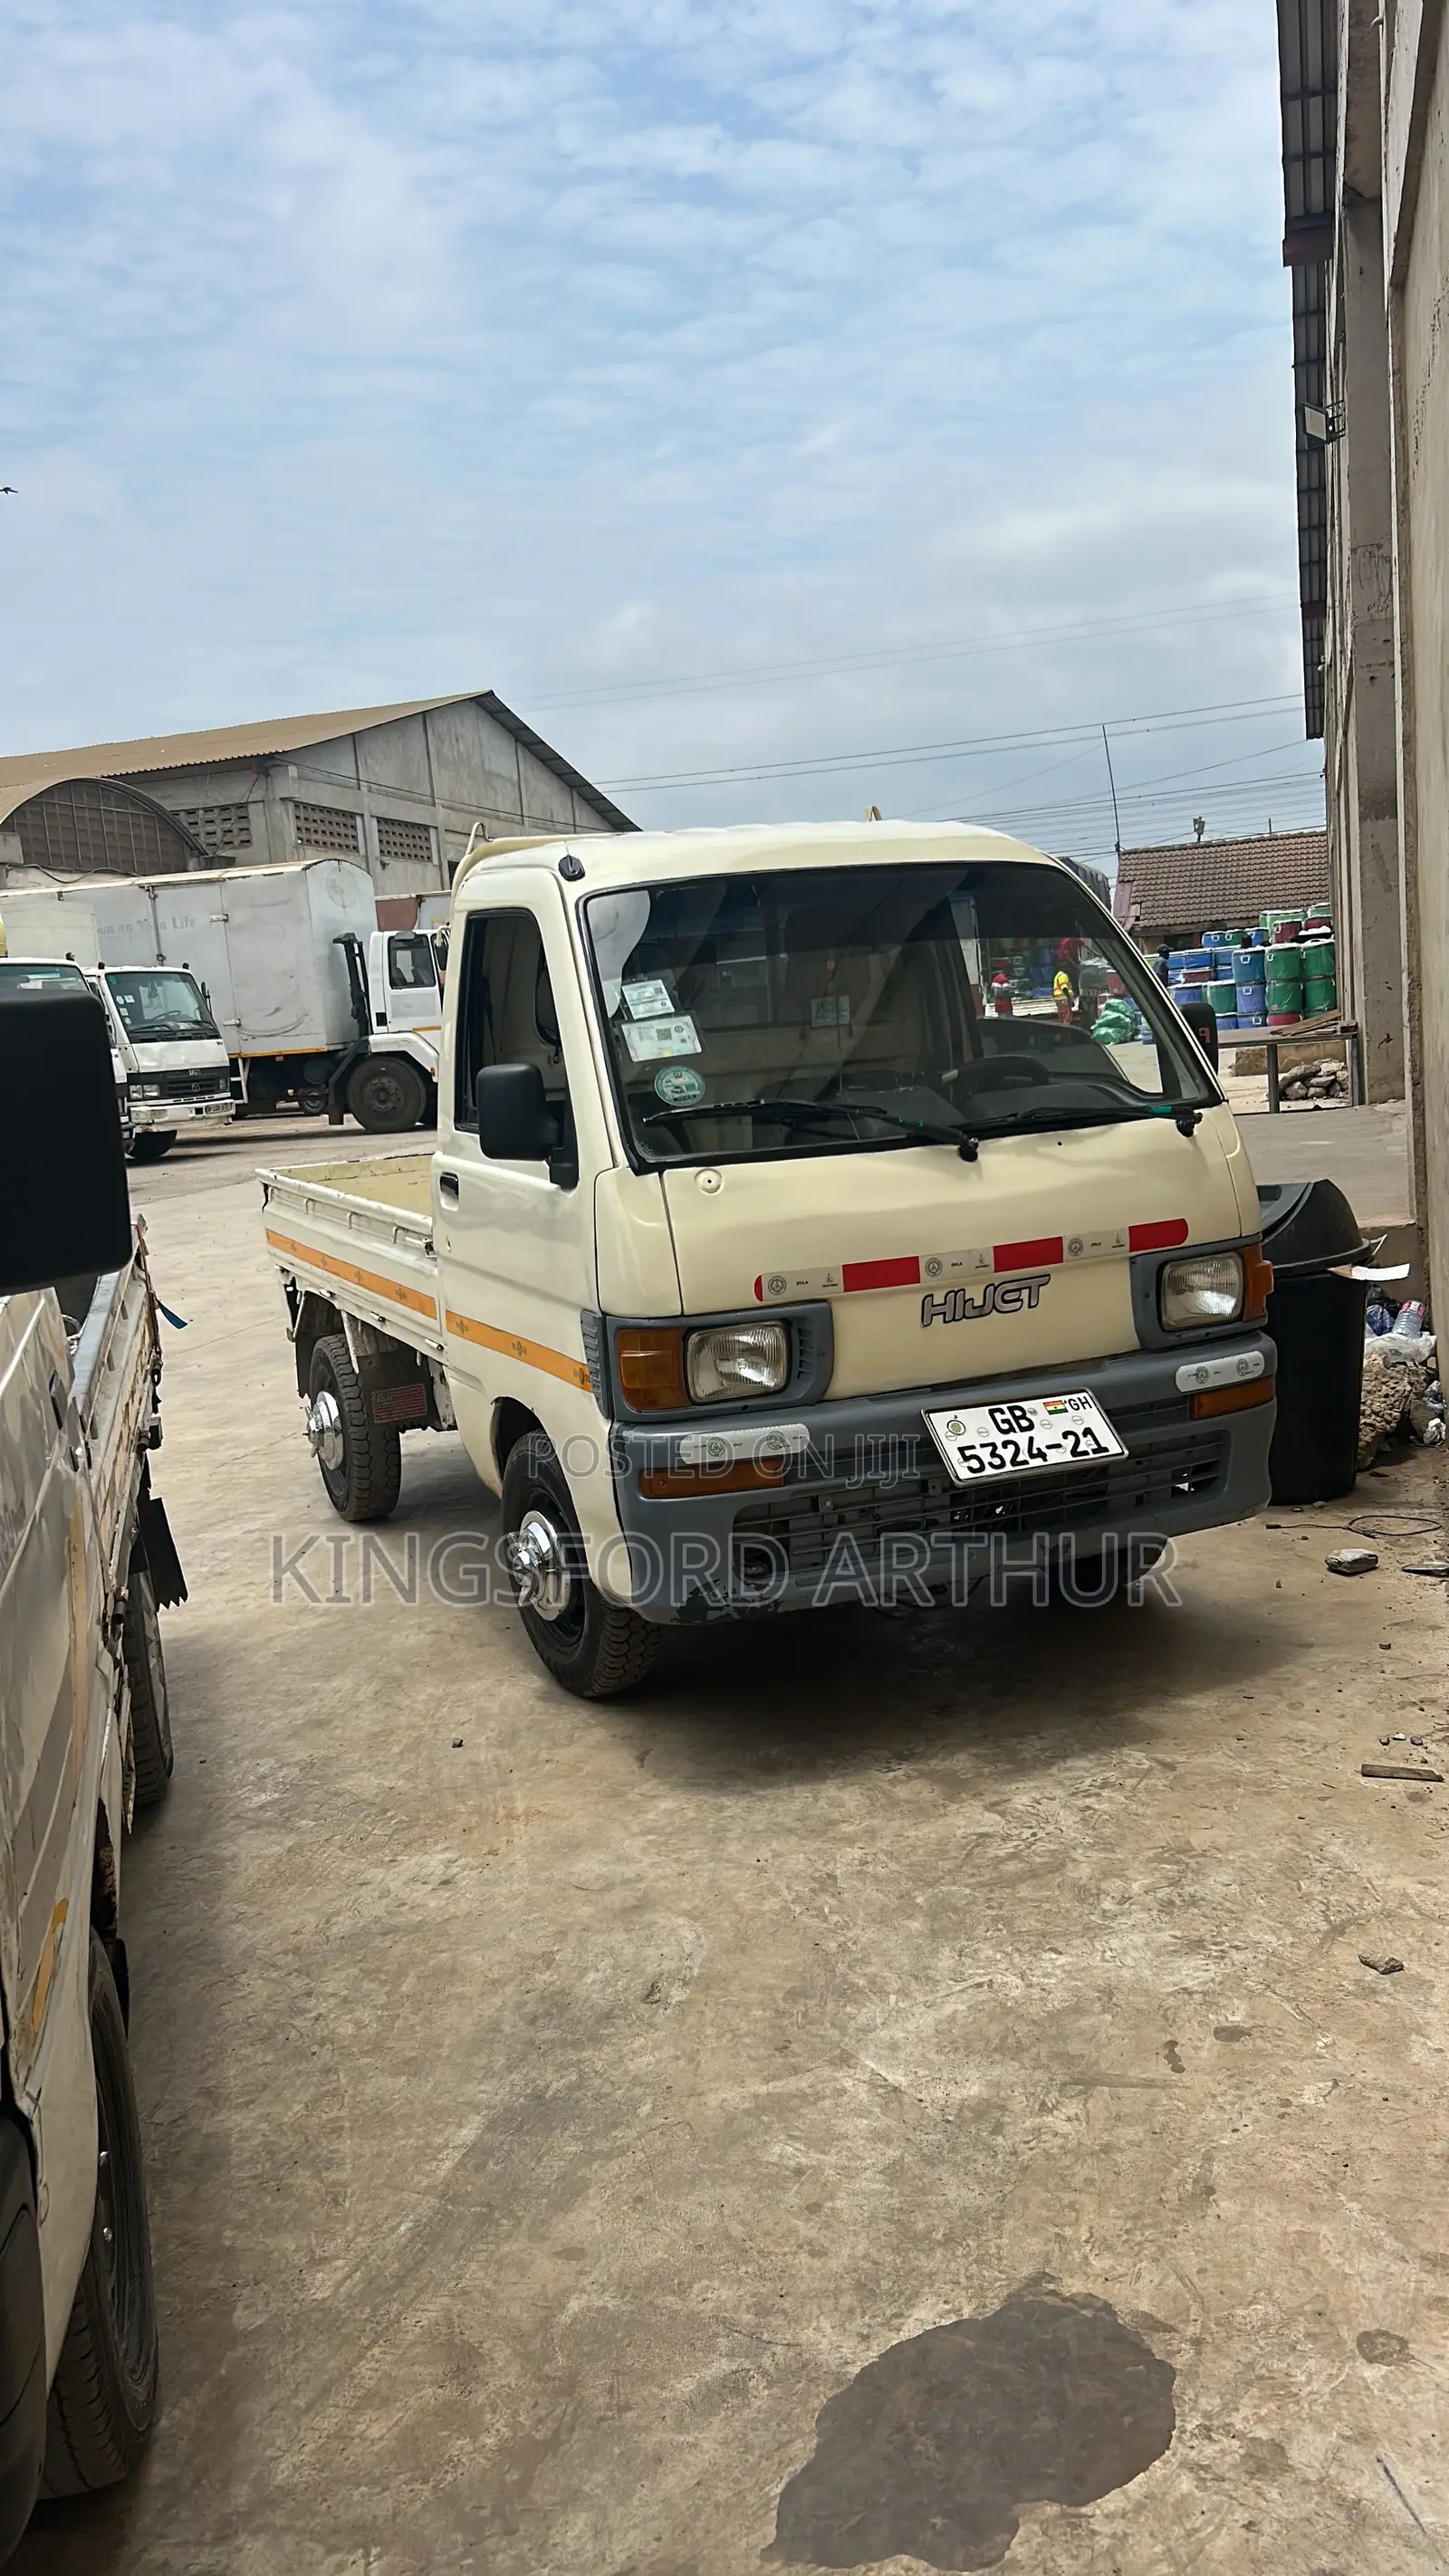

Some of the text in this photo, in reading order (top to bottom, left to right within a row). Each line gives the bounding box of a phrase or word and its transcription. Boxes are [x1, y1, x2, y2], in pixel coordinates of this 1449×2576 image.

[988, 1395, 1093, 1435] GB GH
[957, 1426, 1110, 1474] 5324-21
